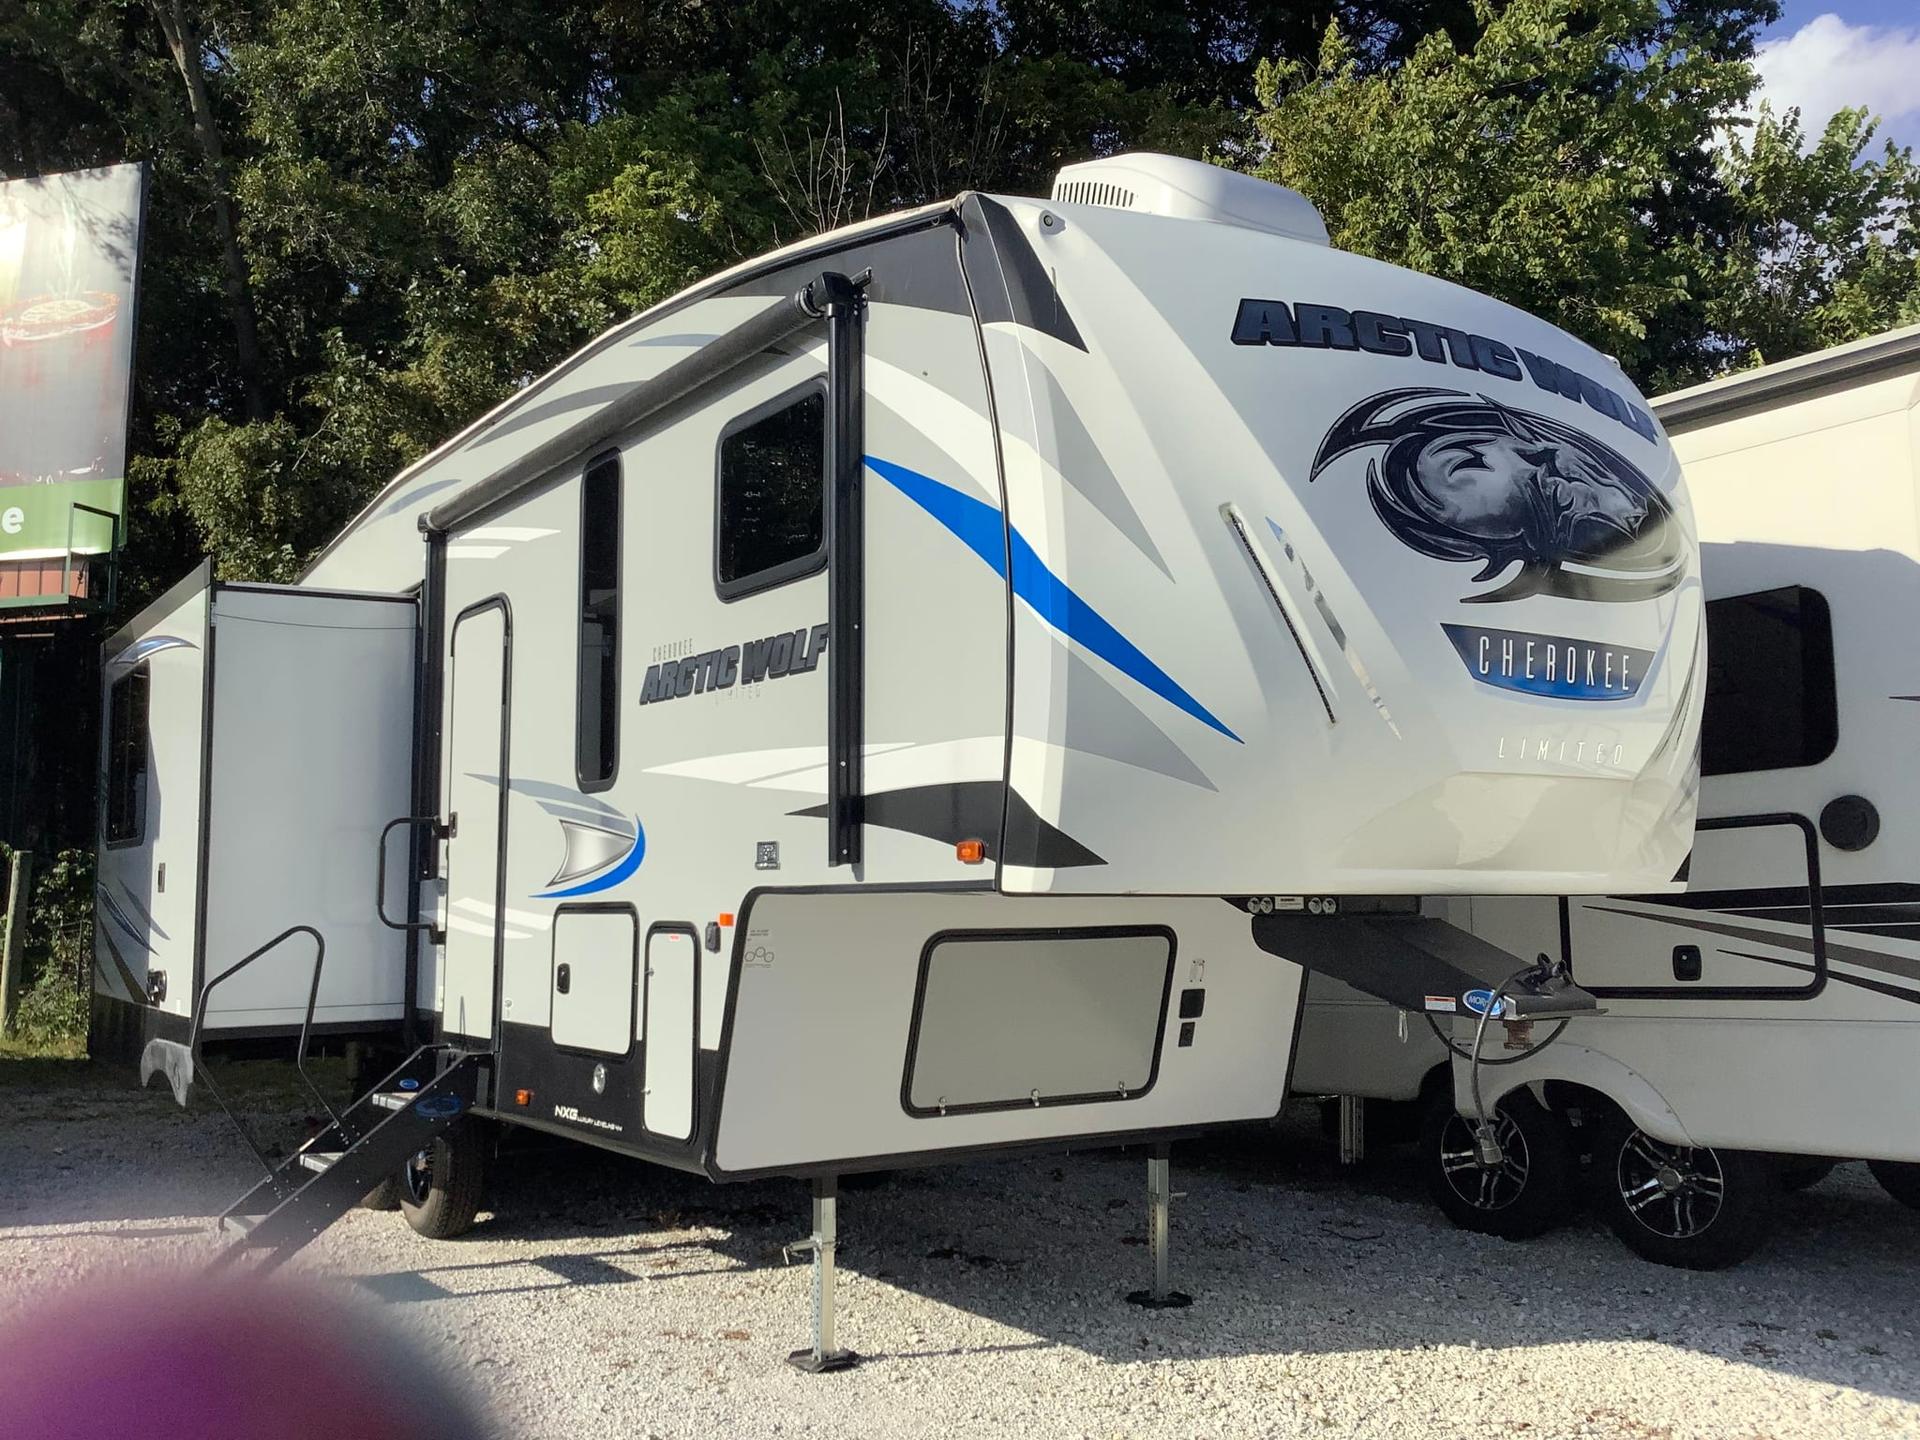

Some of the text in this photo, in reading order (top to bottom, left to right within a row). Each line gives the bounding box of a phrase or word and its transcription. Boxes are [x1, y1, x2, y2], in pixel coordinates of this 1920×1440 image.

[1231, 298, 1523, 381] ARCTIC
[639, 622, 830, 705] ARCTIC WOLF
[1478, 635, 1630, 691] CHEROKEE
[1498, 736, 1624, 766] LIMITED
[554, 1104, 579, 1121] NXG
